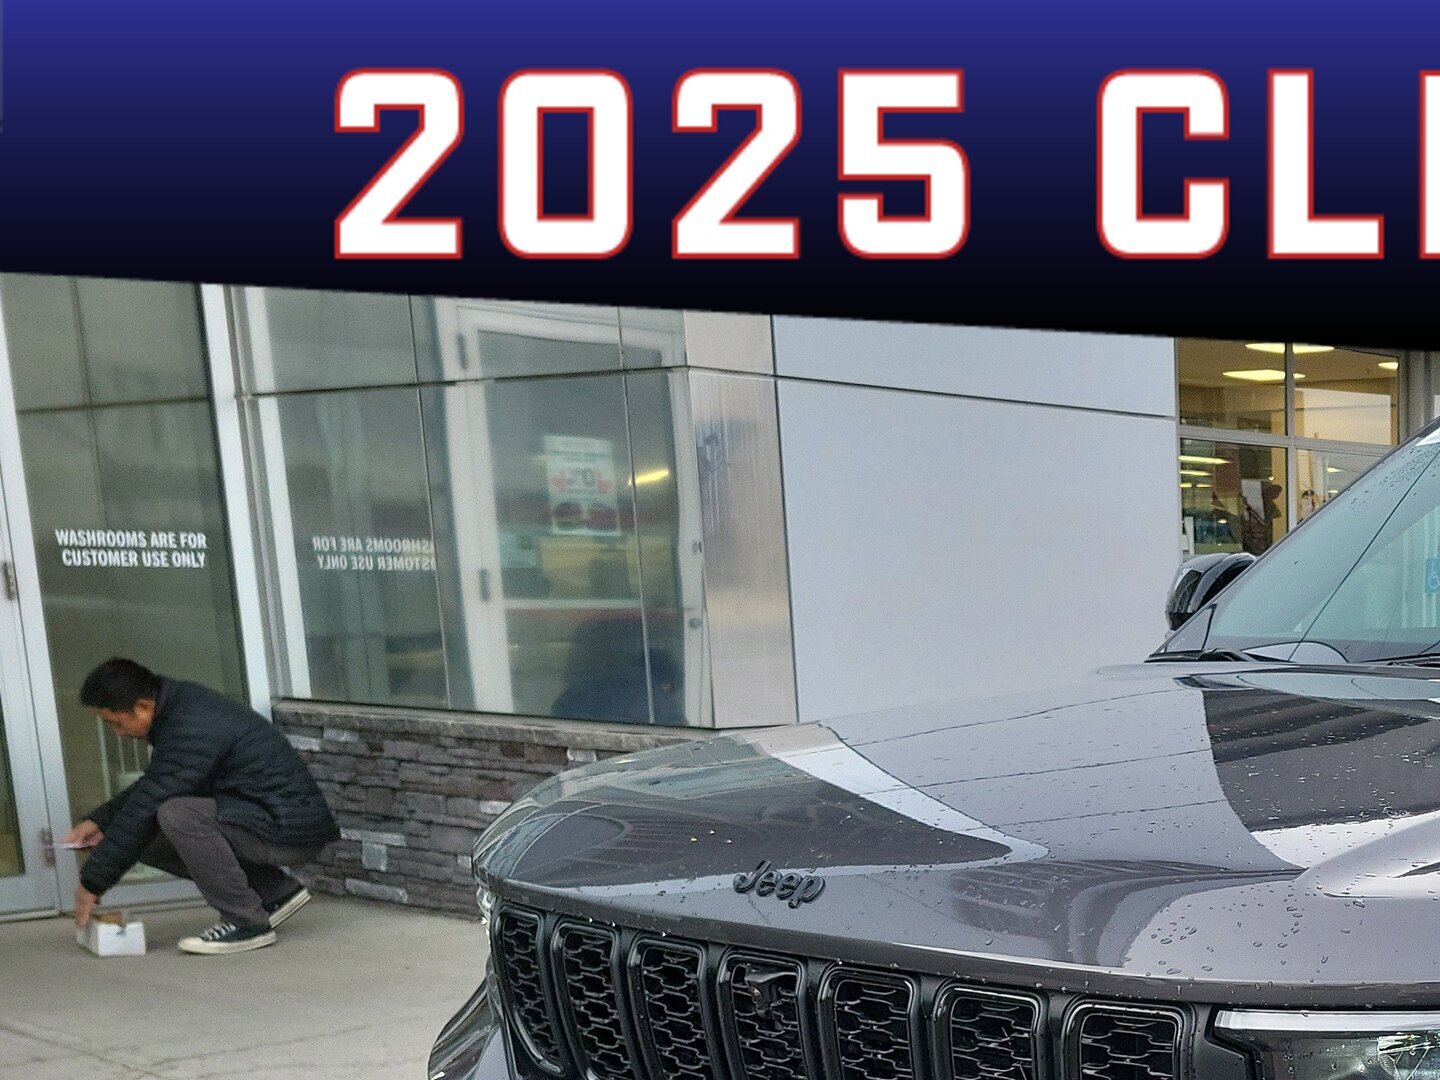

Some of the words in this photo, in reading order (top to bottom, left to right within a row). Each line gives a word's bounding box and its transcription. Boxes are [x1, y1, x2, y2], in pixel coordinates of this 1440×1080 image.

[54, 528, 147, 548] WASHROOMS
[150, 531, 177, 549] ARE
[179, 531, 208, 549] FOR
[62, 549, 138, 568] CUSTOMER
[141, 550, 170, 568] USE
[171, 550, 206, 569] ONLY
[733, 859, 826, 909] Jeep
